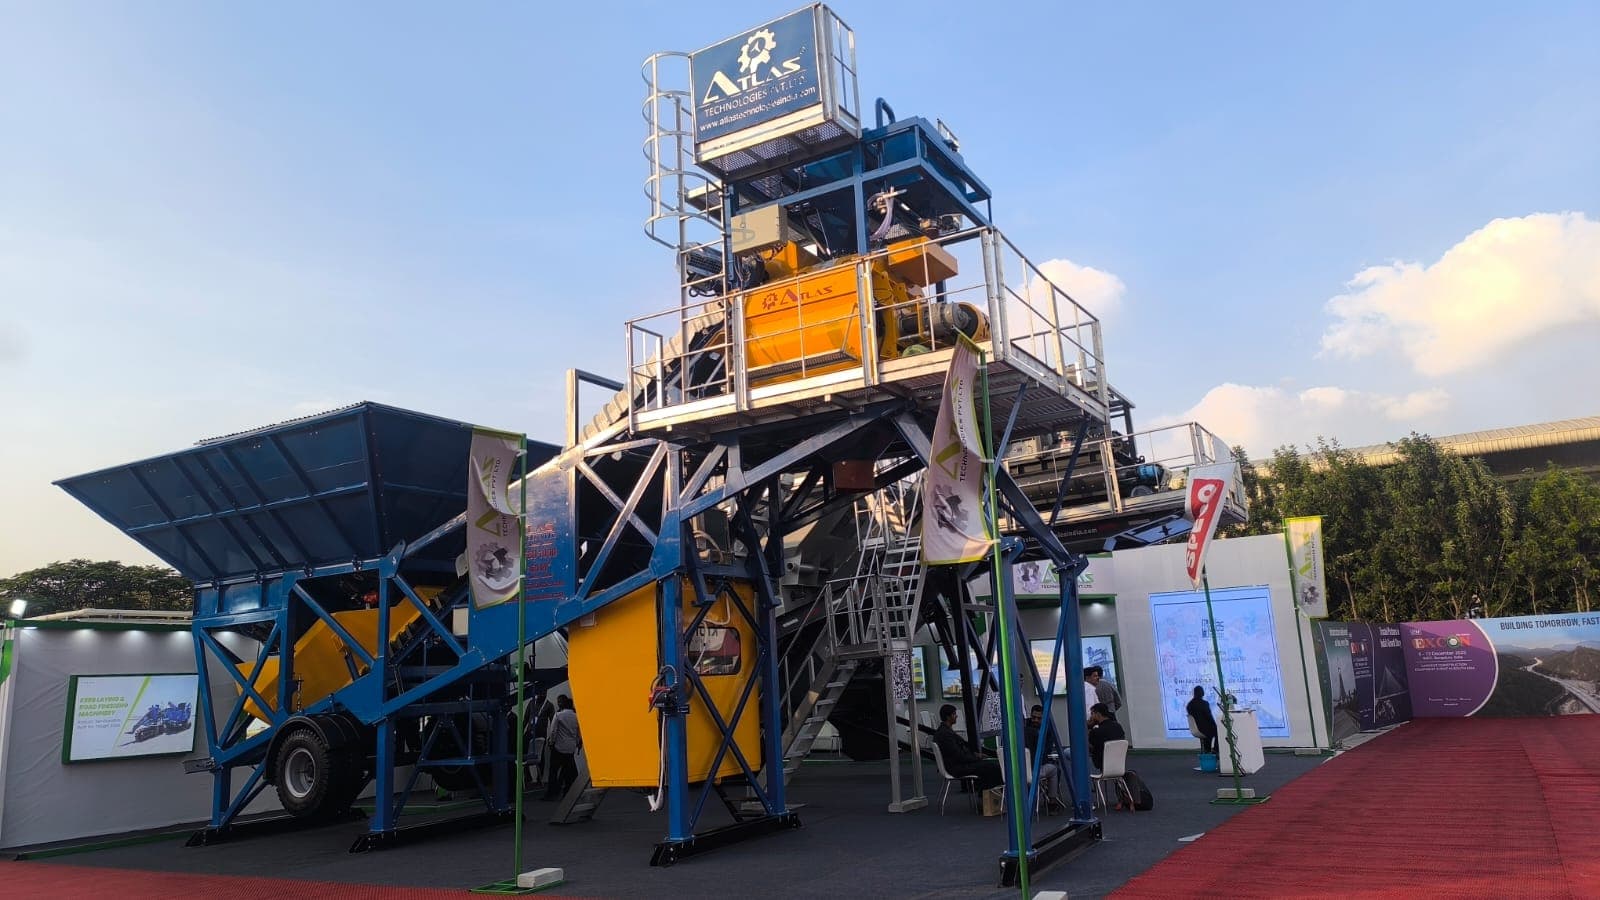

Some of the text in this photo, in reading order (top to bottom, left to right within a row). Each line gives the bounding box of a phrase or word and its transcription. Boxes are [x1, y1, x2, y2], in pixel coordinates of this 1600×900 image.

[703, 57, 801, 104] ATLAS
[704, 88, 768, 117] TECHNOLOGIES
[780, 286, 833, 305] ATLAS
[1500, 616, 1600, 630] BUILDING TOMORROW, FAST
